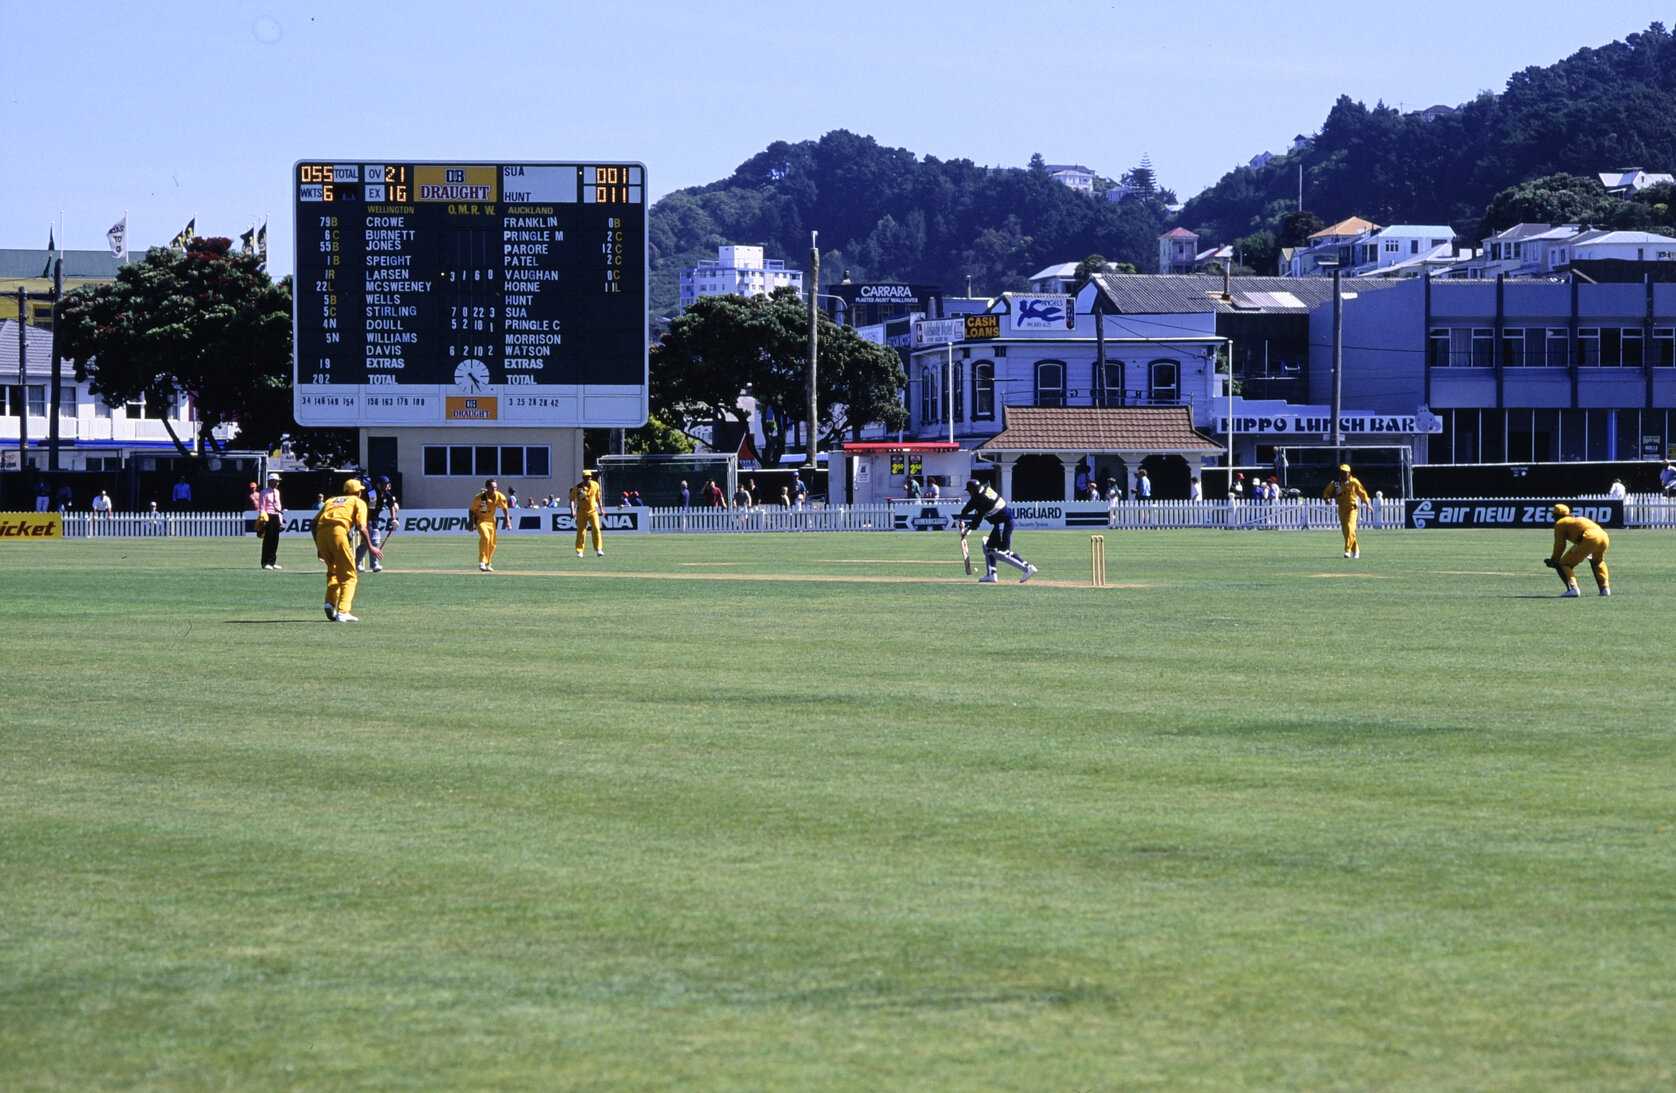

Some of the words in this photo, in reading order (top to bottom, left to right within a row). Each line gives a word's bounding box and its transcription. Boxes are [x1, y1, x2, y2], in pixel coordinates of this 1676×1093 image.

[301, 166, 333, 182] 055
[334, 169, 358, 178] TOTAL
[369, 169, 381, 178] OV
[385, 166, 405, 182] 21
[504, 166, 525, 176] SUA
[597, 168, 627, 184] 001
[300, 188, 322, 198] WKTS
[323, 186, 334, 201] 6
[369, 188, 380, 198] EX
[389, 186, 407, 201] 16
[420, 184, 490, 200] DRAUGHT
[504, 192, 531, 202] HUNT
[597, 187, 627, 203] 011
[368, 206, 414, 214] WELLINGTON
[508, 206, 553, 214] AUCKLAND
[366, 217, 404, 227] CROWE
[504, 217, 558, 228] FRANKLIN
[365, 230, 415, 240] BURNETT
[504, 231, 549, 241] PRINGLE
[555, 231, 563, 241] M
[366, 241, 402, 251] JONES
[504, 244, 548, 254] PARORE
[366, 256, 412, 266] SPEIGHT
[504, 256, 539, 266] PATEL
[366, 269, 409, 280] LARSEN
[450, 272, 455, 282] 3
[475, 271, 480, 280] 6
[505, 270, 558, 280] VAUGHAN
[366, 282, 432, 292] MCSWEENEY
[505, 281, 540, 292] HORNE
[861, 286, 912, 297] CARRARA
[366, 294, 400, 304] WELLS
[505, 295, 533, 305] HUNT
[366, 306, 417, 316] STIRLING
[452, 307, 457, 317] 7
[473, 307, 484, 318] 22
[490, 307, 495, 318] 3
[506, 308, 527, 318] SUA
[366, 320, 404, 330] DOULL
[452, 319, 457, 329] 5
[462, 319, 468, 329] 2
[474, 320, 483, 330] 10
[505, 320, 549, 330] PRINGLE
[553, 320, 560, 330] C
[967, 316, 997, 327] CASH
[965, 327, 999, 338] LOANS
[366, 333, 418, 343] WILLIAMS
[505, 334, 561, 344] MORRISON
[366, 345, 402, 355] DAVIS
[463, 346, 469, 356] 2
[474, 346, 483, 356] 10
[488, 345, 493, 356] 2
[505, 346, 550, 356] WATSON
[320, 359, 330, 368] 19
[366, 358, 405, 368] EXTRAS
[505, 359, 544, 369] EXTRAS
[312, 374, 330, 384] 202
[368, 374, 398, 384] TOTAL
[506, 375, 537, 384] TOTAL
[453, 410, 490, 418] DRAUGHT
[1221, 418, 1287, 432] HIPPO
[1370, 418, 1414, 431] BAR
